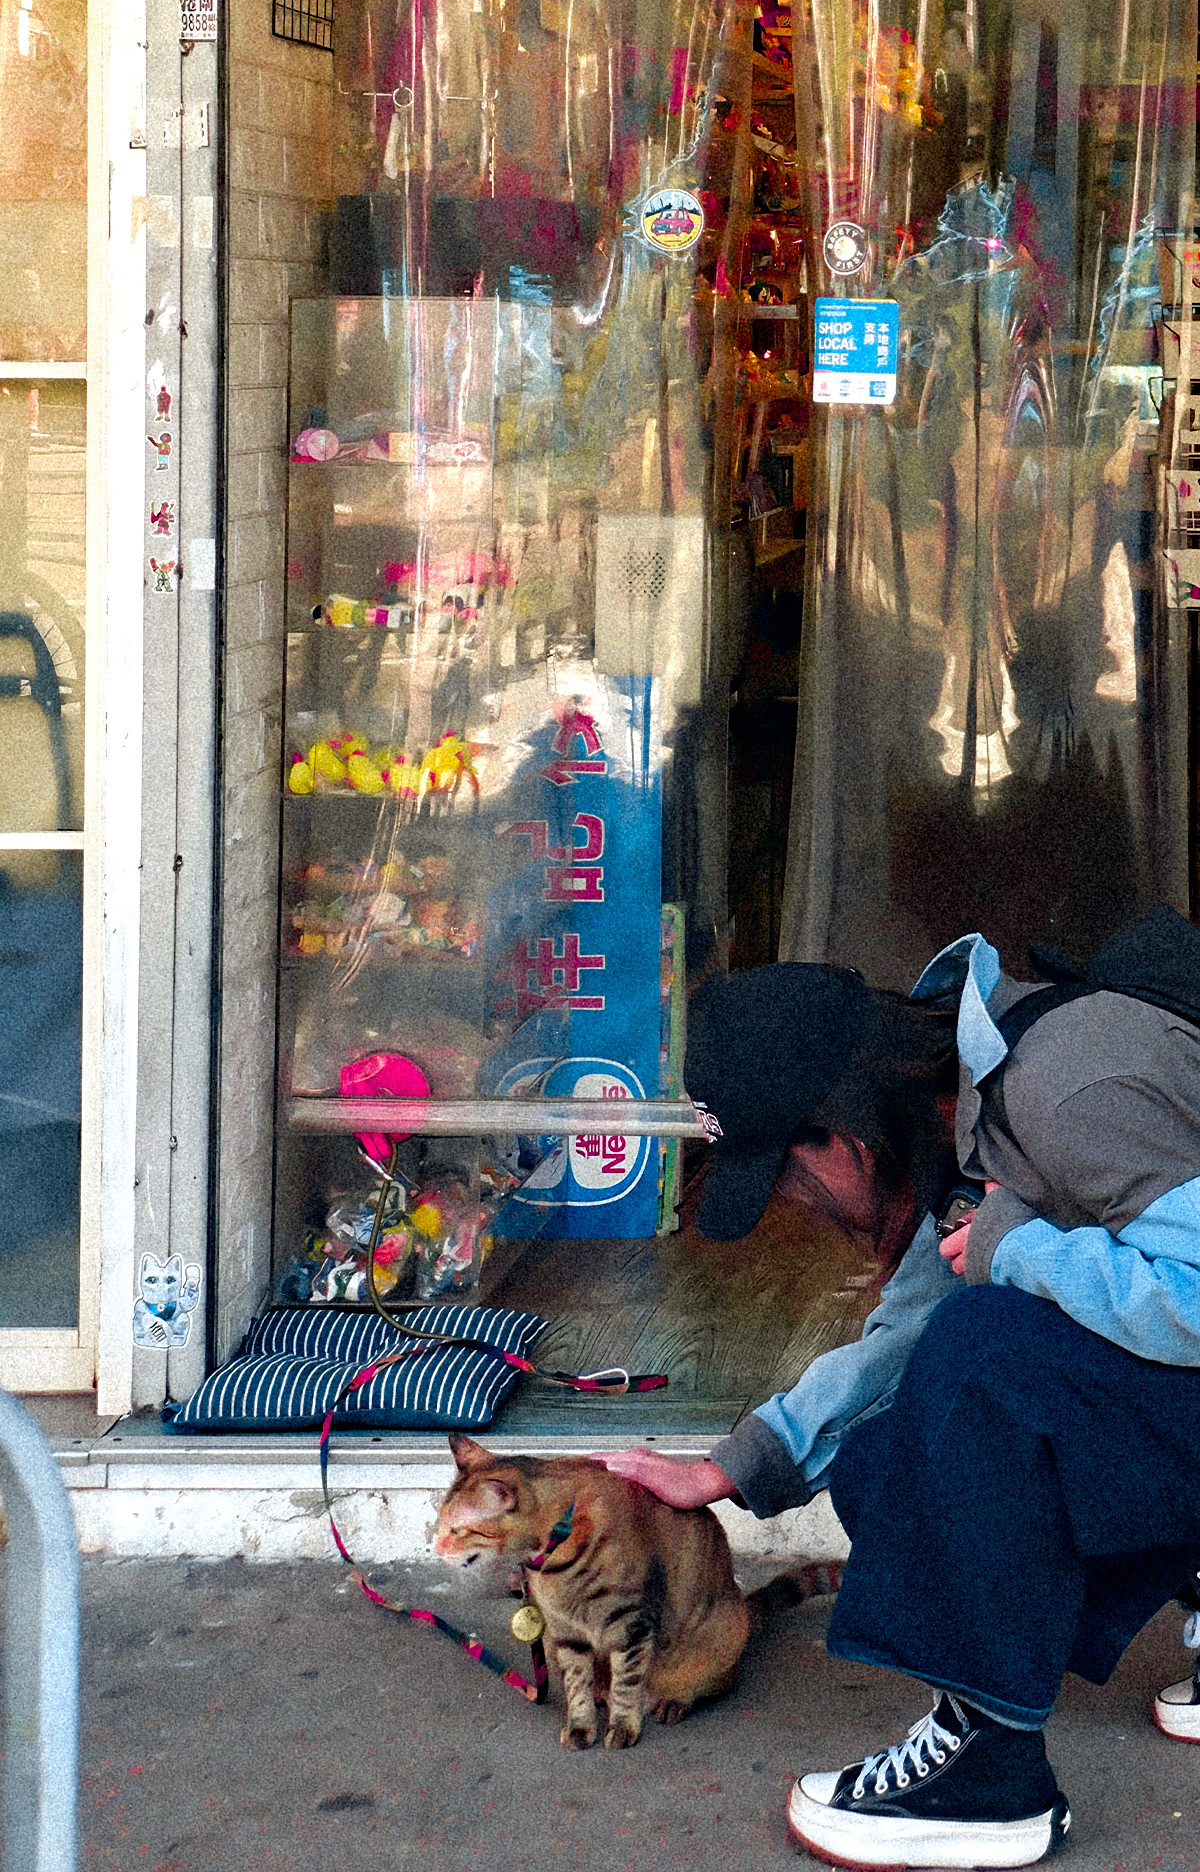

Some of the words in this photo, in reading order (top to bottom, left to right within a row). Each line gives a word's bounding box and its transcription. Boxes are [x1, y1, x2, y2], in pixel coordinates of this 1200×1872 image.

[826, 227, 859, 250] SAFETY
[835, 250, 864, 270] FIRST
[818, 322, 853, 335] SHOP
[818, 337, 858, 351] LOCAL
[817, 352, 849, 366] HERE
